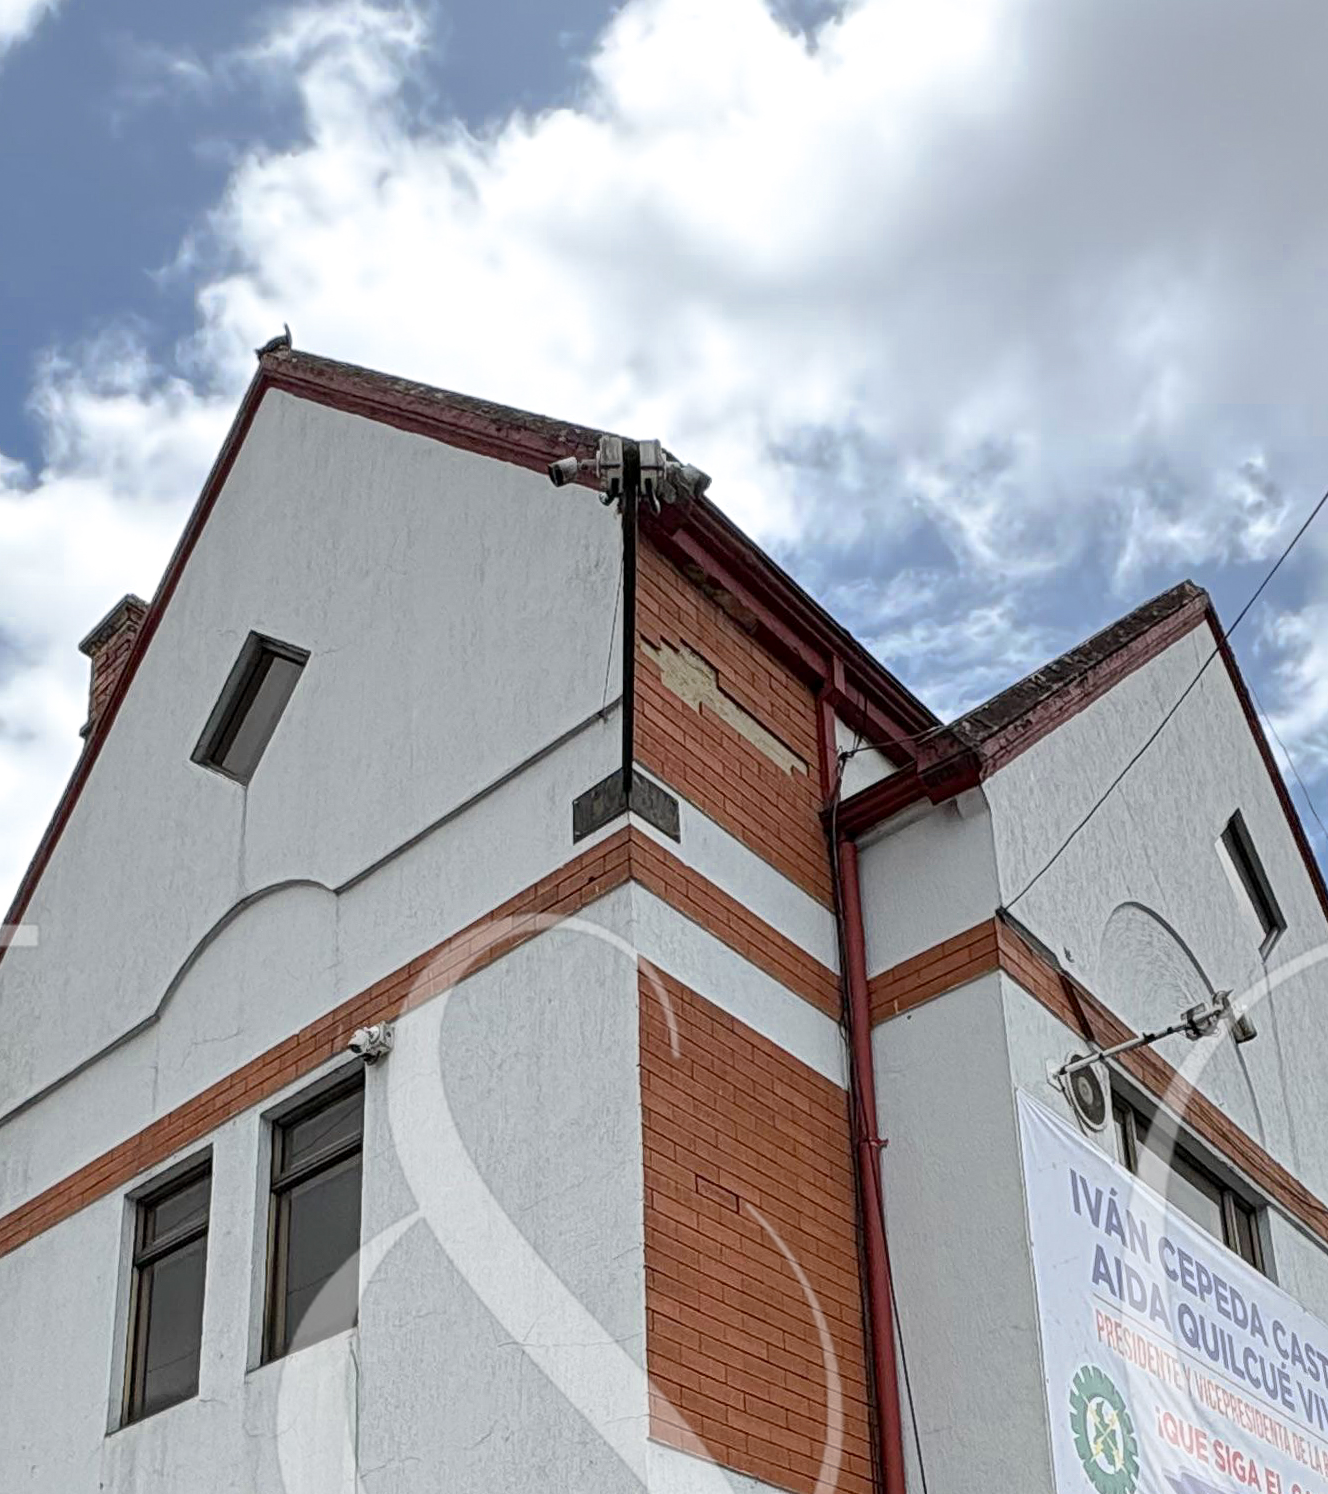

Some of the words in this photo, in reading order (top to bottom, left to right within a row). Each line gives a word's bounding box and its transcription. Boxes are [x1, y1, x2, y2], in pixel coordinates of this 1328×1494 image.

[1069, 1168, 1151, 1264] IVÁN
[1158, 1236, 1269, 1347] CEPEDA
[1092, 1243, 1173, 1333] AIDA
[1177, 1303, 1296, 1412] QUILCUÉ
[1095, 1309, 1183, 1391] PRESIDENTE
[1181, 1363, 1193, 1398] Y
[1193, 1371, 1292, 1457] VICEPRESIDENTA
[1292, 1431, 1307, 1465] DE
[1307, 1441, 1322, 1473] LA
[1155, 1406, 1209, 1464] ¡QUE
[1212, 1439, 1262, 1493] SIGA
